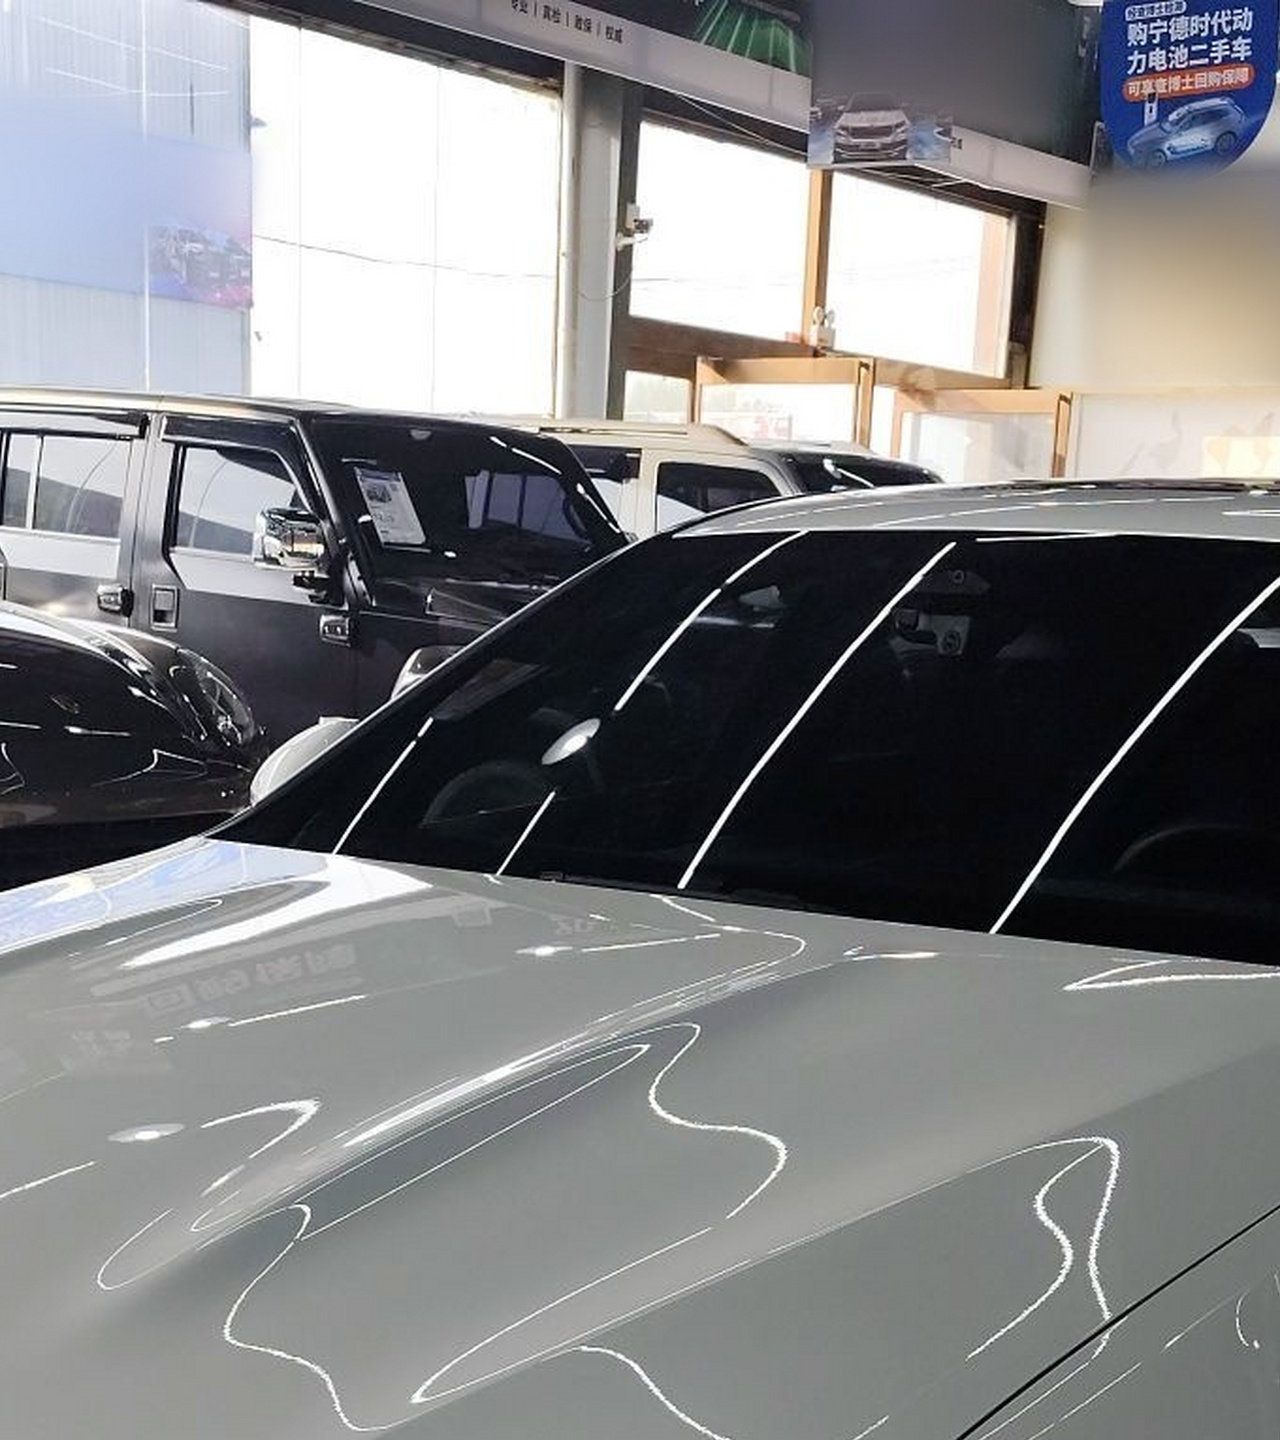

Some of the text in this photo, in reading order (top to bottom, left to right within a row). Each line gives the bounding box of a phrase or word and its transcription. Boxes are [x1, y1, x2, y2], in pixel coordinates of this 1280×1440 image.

[1126, 7, 1254, 47] 购宁德时代动
[1126, 36, 1253, 75] 力电池二手车
